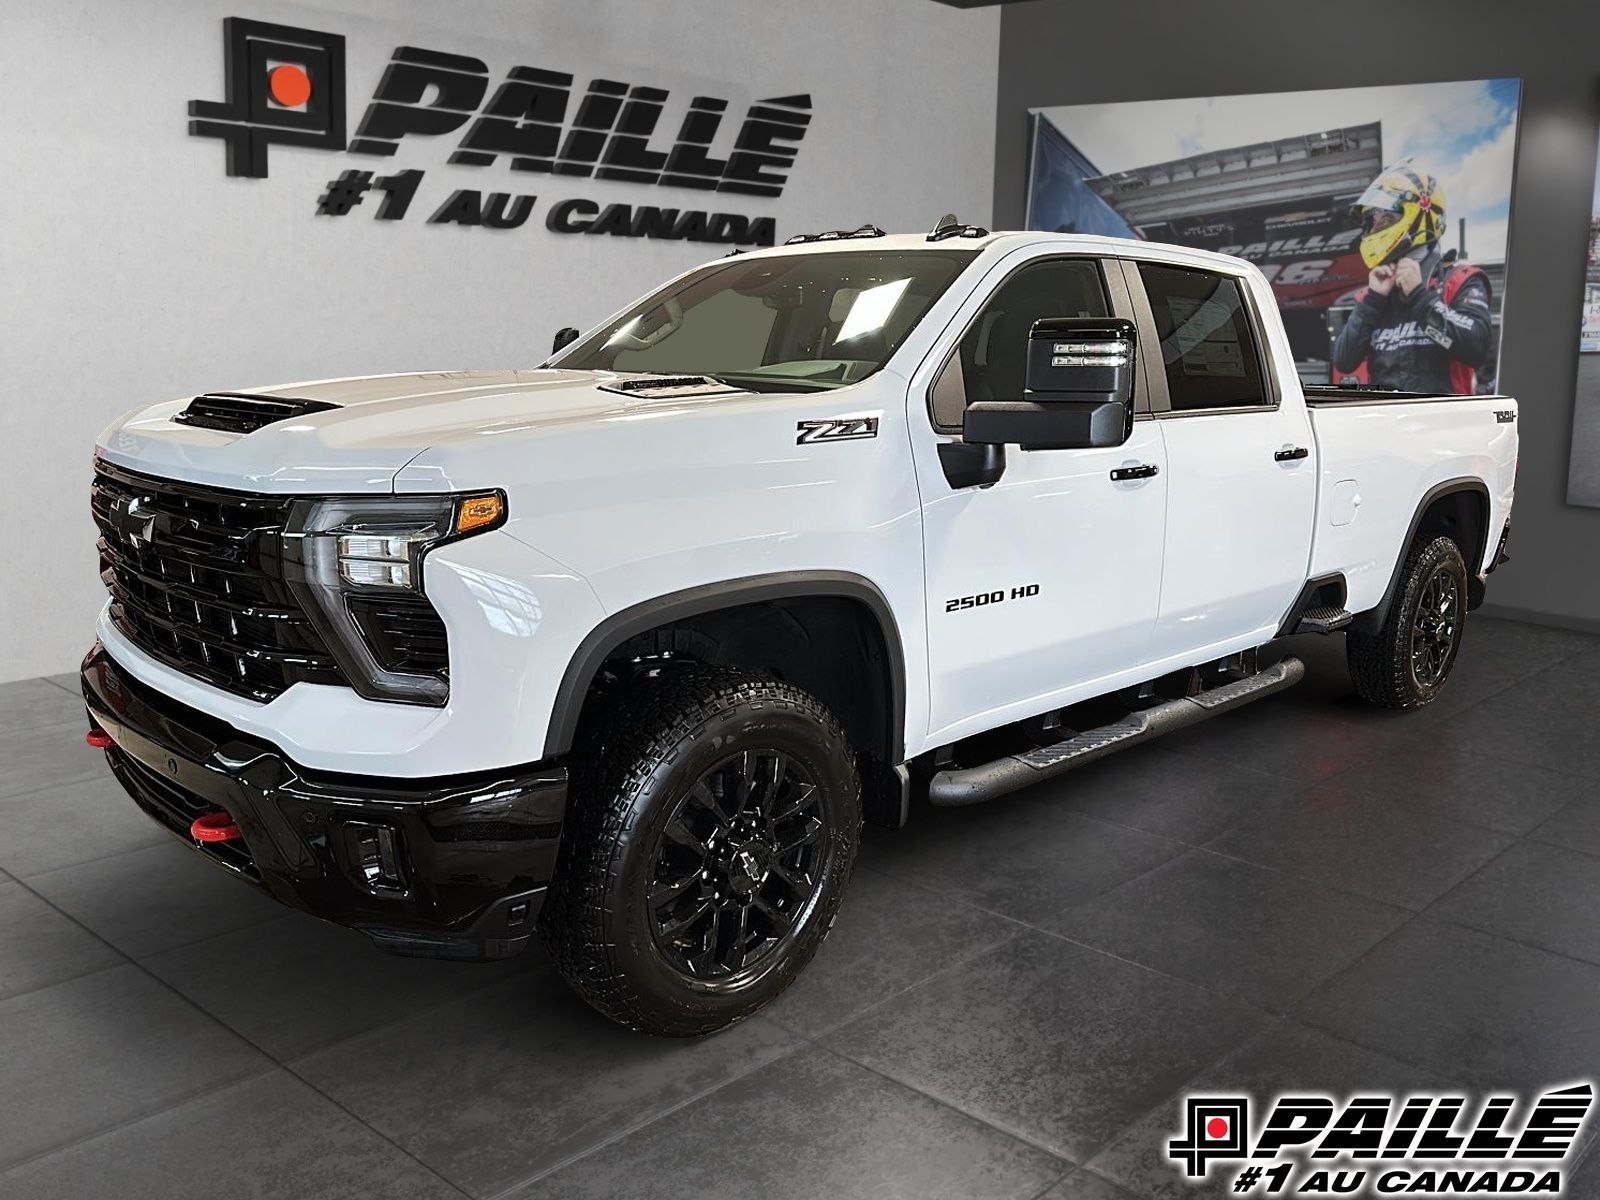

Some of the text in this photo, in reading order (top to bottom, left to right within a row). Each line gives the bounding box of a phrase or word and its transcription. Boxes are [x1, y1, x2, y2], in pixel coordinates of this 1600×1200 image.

[347, 46, 812, 197] PAILLÉ
[315, 169, 776, 246] #1 AU CANADA
[1268, 244, 1350, 257] CANADA
[796, 417, 879, 445] Z71
[945, 584, 1040, 612] 2500 HD
